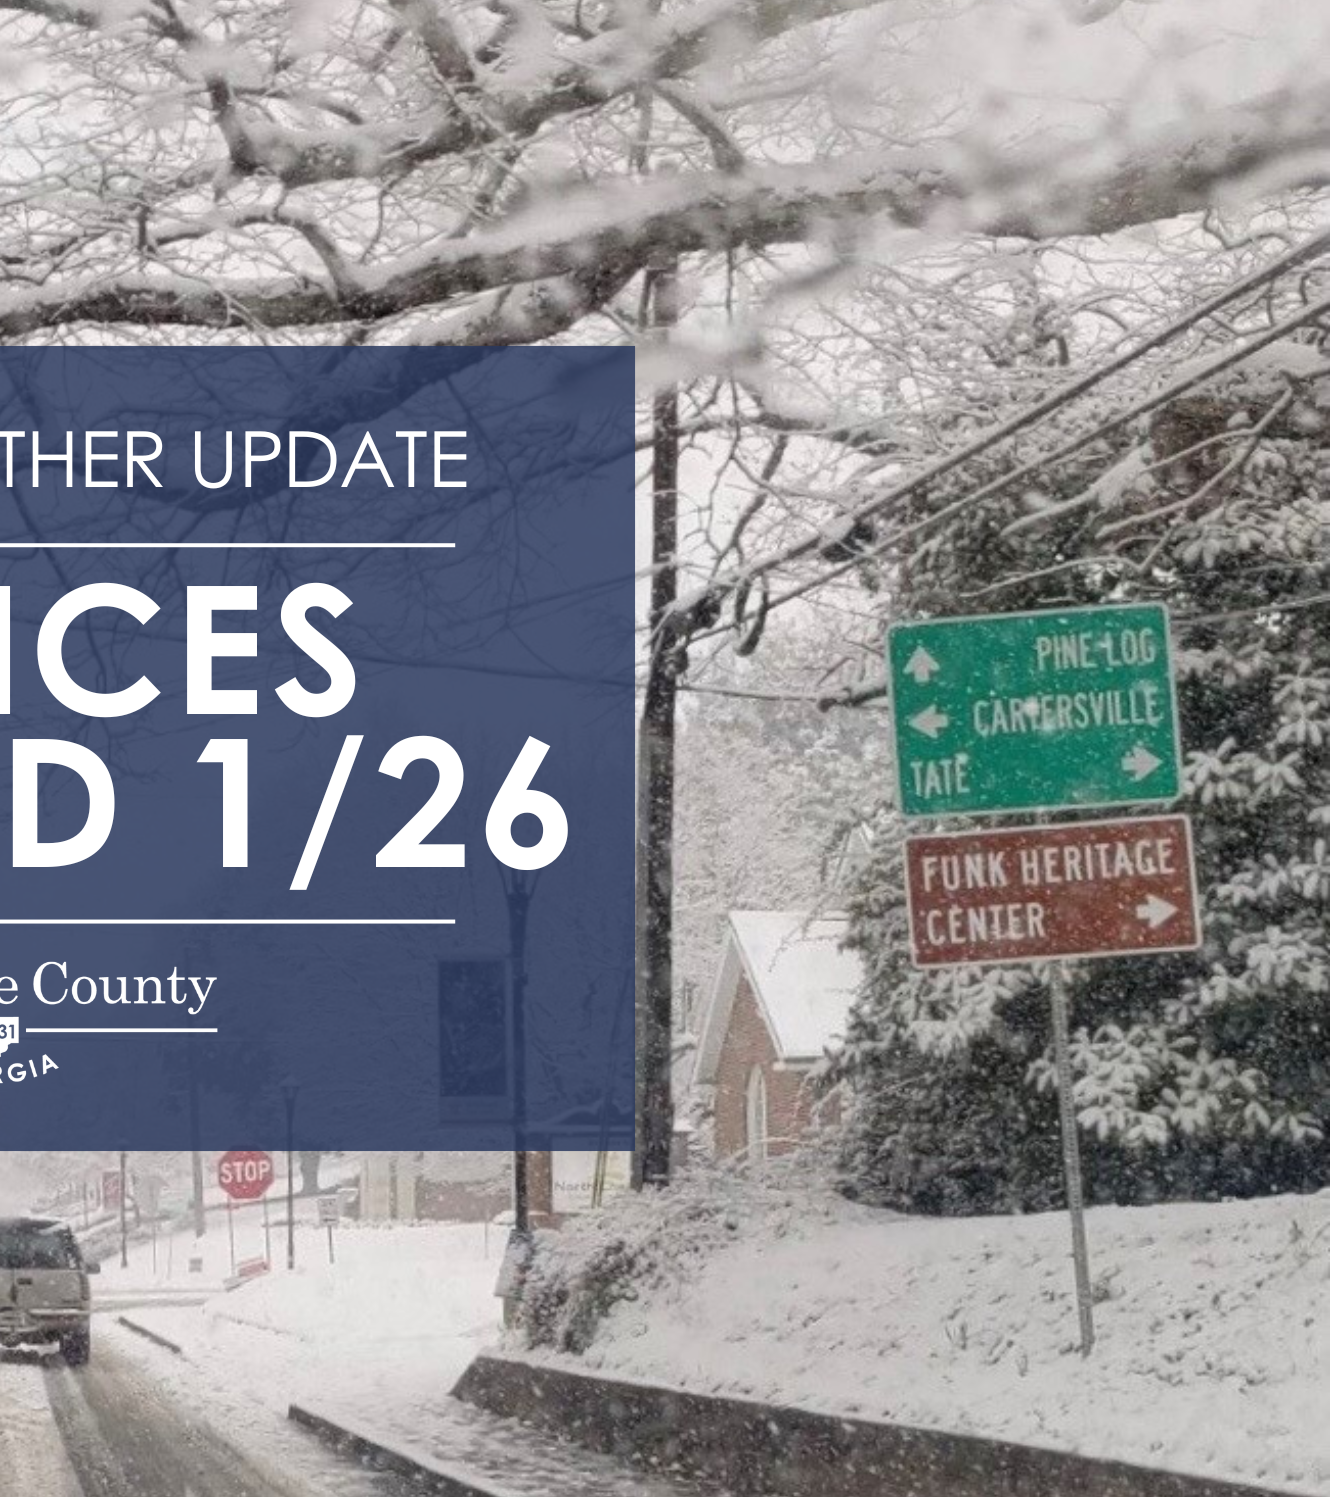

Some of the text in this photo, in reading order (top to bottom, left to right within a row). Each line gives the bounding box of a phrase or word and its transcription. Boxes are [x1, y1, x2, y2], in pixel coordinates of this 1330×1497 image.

[1036, 628, 1155, 670] PINE LOG
[974, 687, 1163, 735] CARTERSVILLE
[911, 756, 970, 799] TATE
[923, 839, 1175, 892] FUNK HERITAGE
[927, 903, 1046, 946] CENTER
[221, 1160, 270, 1183] STOP
